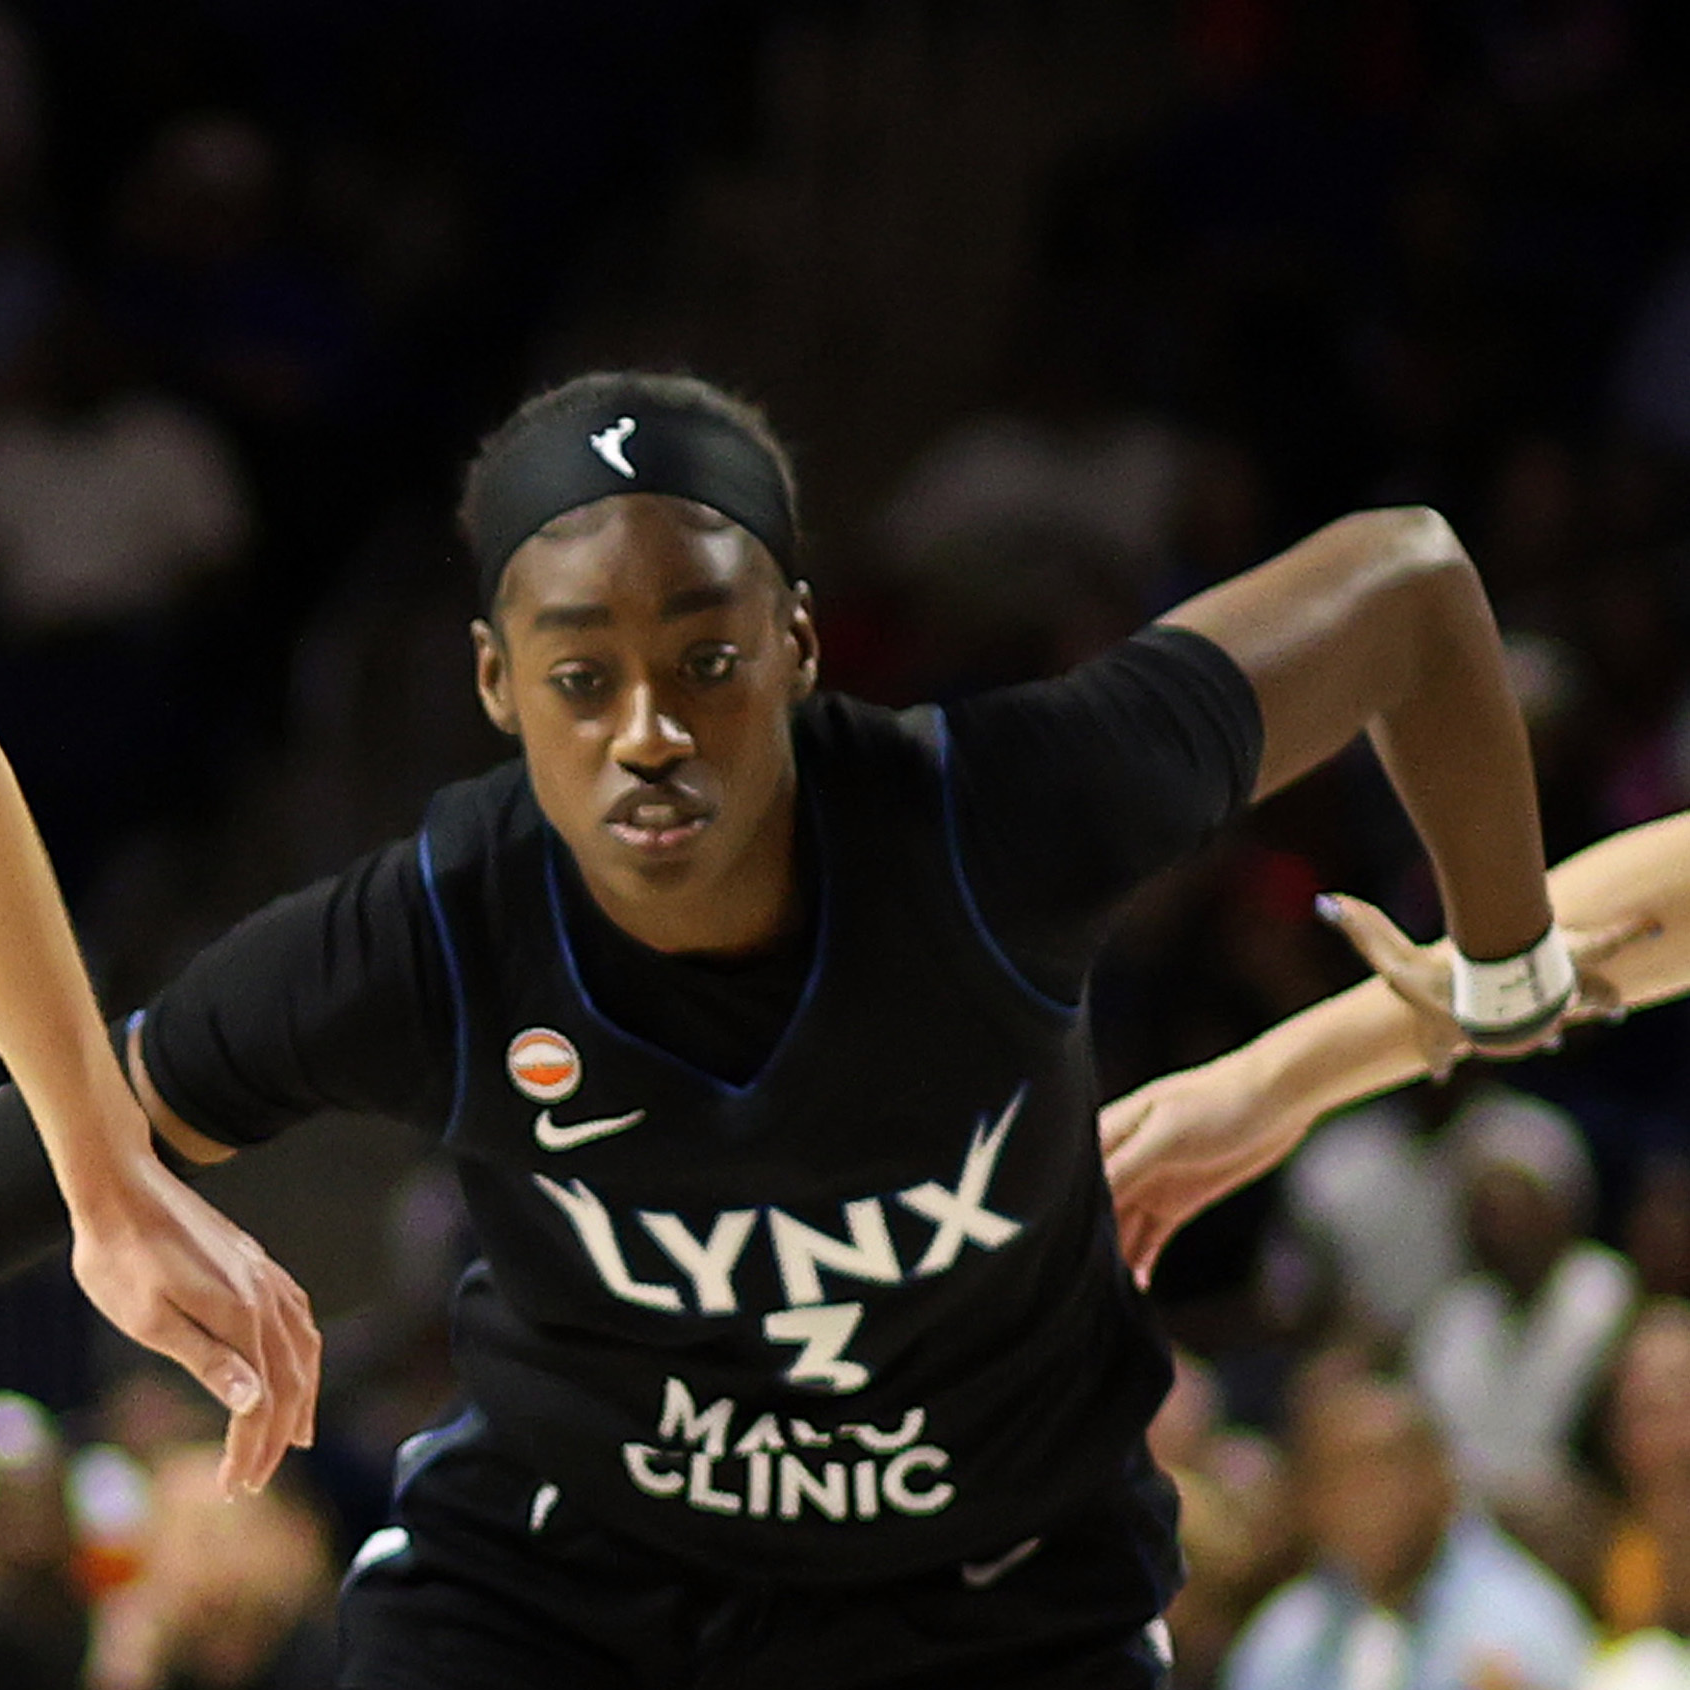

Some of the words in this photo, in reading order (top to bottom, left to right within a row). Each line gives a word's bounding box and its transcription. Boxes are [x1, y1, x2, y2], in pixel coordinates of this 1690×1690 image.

[533, 1080, 1025, 1316] LYNX
[763, 1302, 870, 1394] 3
[657, 1375, 926, 1461] MA
[622, 1442, 957, 1522] CLINIC
